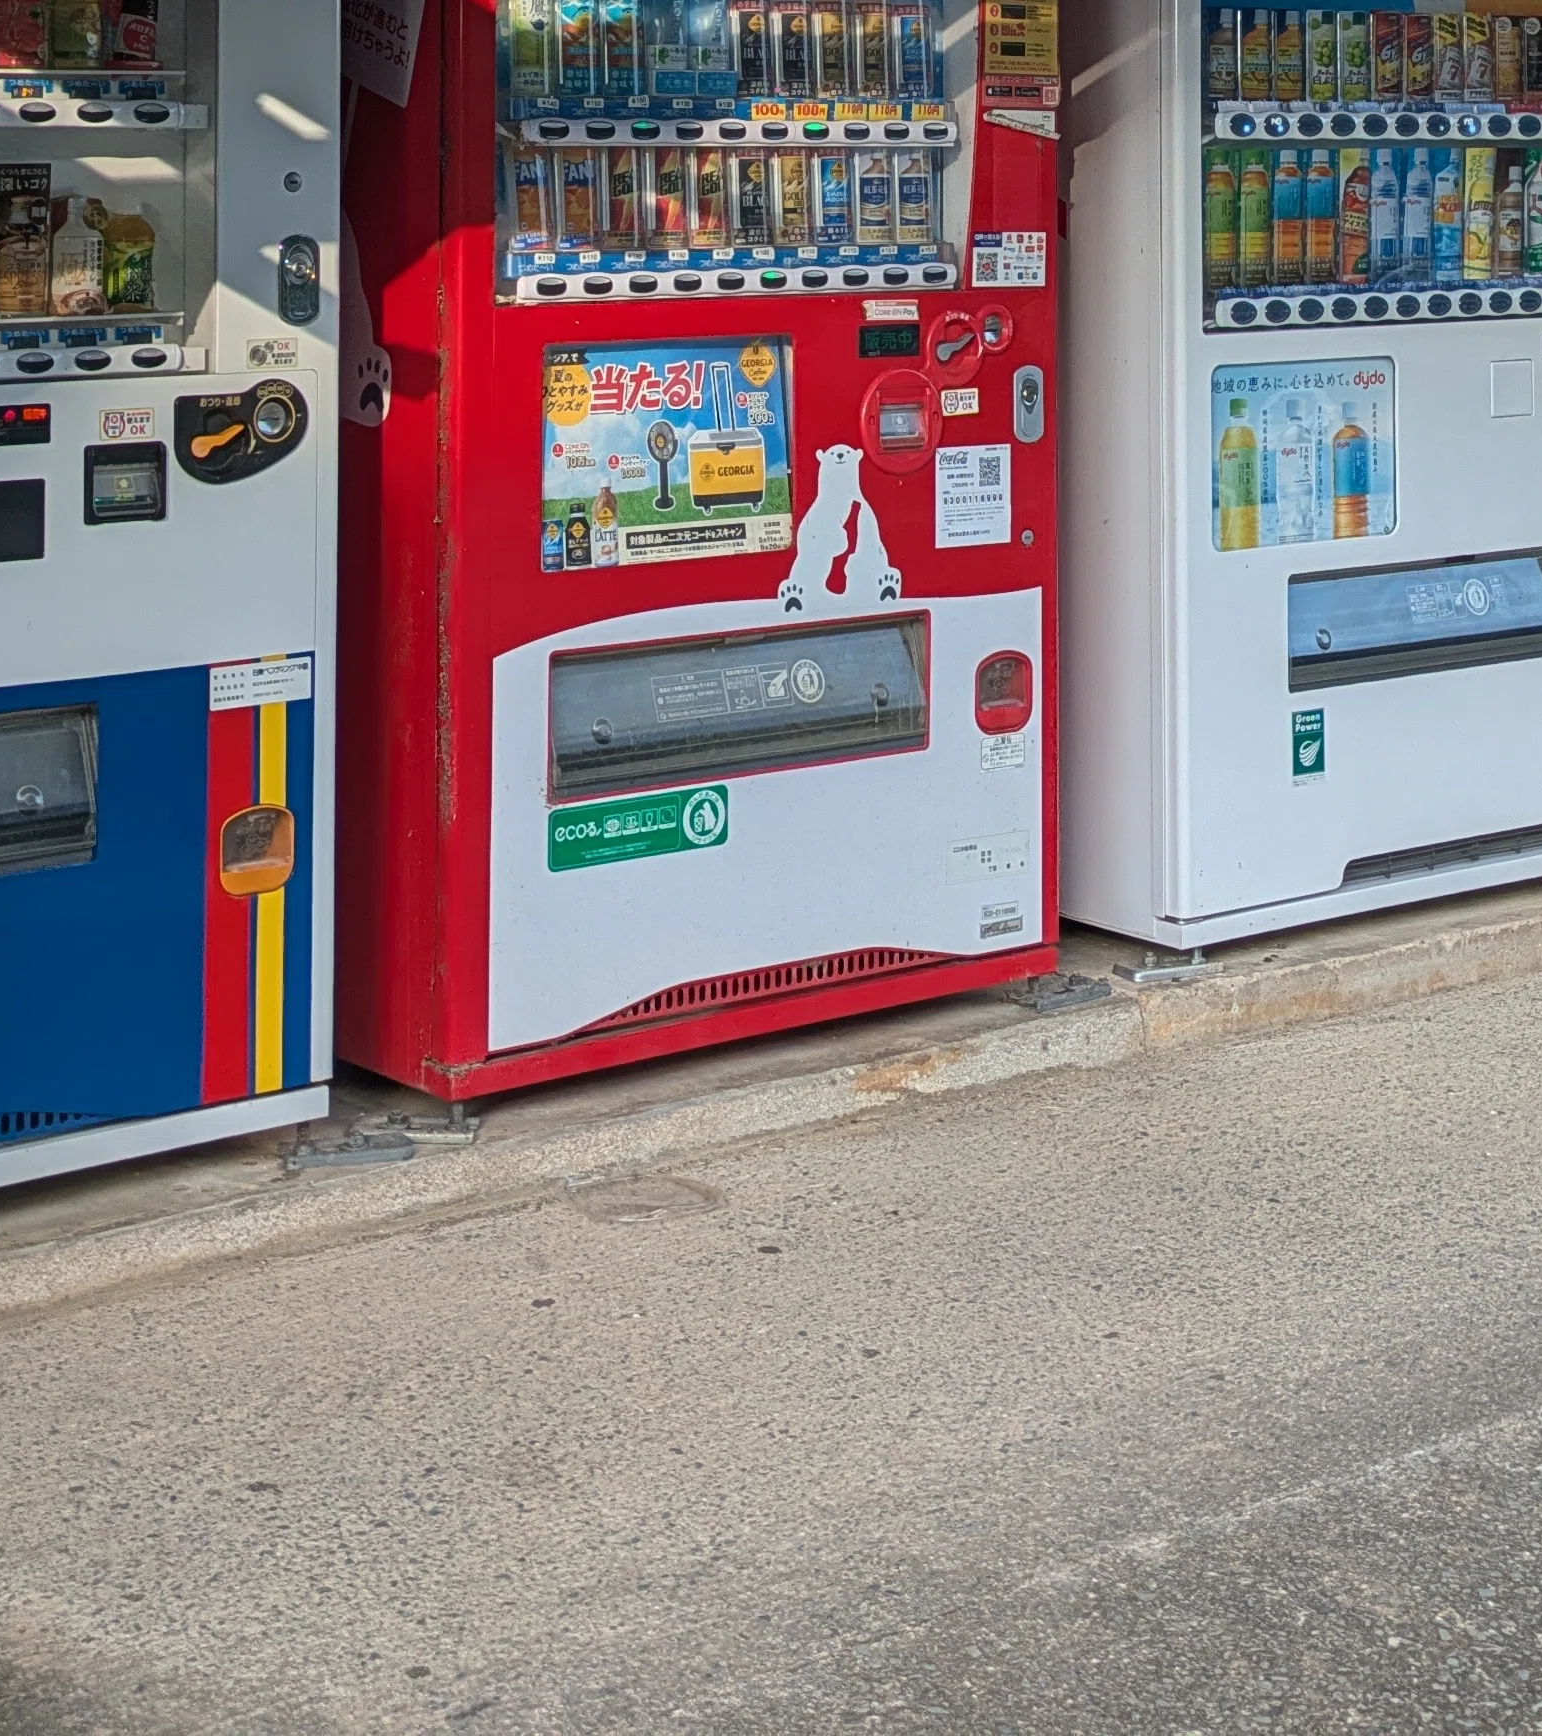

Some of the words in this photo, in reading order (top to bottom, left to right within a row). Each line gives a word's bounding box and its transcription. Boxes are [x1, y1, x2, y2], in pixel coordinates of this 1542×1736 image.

[796, 104, 826, 116] 100円
[276, 341, 291, 351] OK
[864, 330, 914, 351] 販売中
[552, 368, 573, 383] 夏の
[1210, 371, 1351, 394] 地域の恵みに、心を込めて。
[1353, 369, 1386, 390] dydo
[589, 360, 705, 415] 当たる!
[546, 400, 583, 412] グッズが
[129, 423, 147, 435] OK
[717, 464, 756, 477] GEORGIA
[594, 529, 618, 543] LATTE
[629, 527, 744, 547] 対象製品の二次元コードをスキャン
[1295, 712, 1321, 724] Green
[1295, 722, 1322, 733] Power
